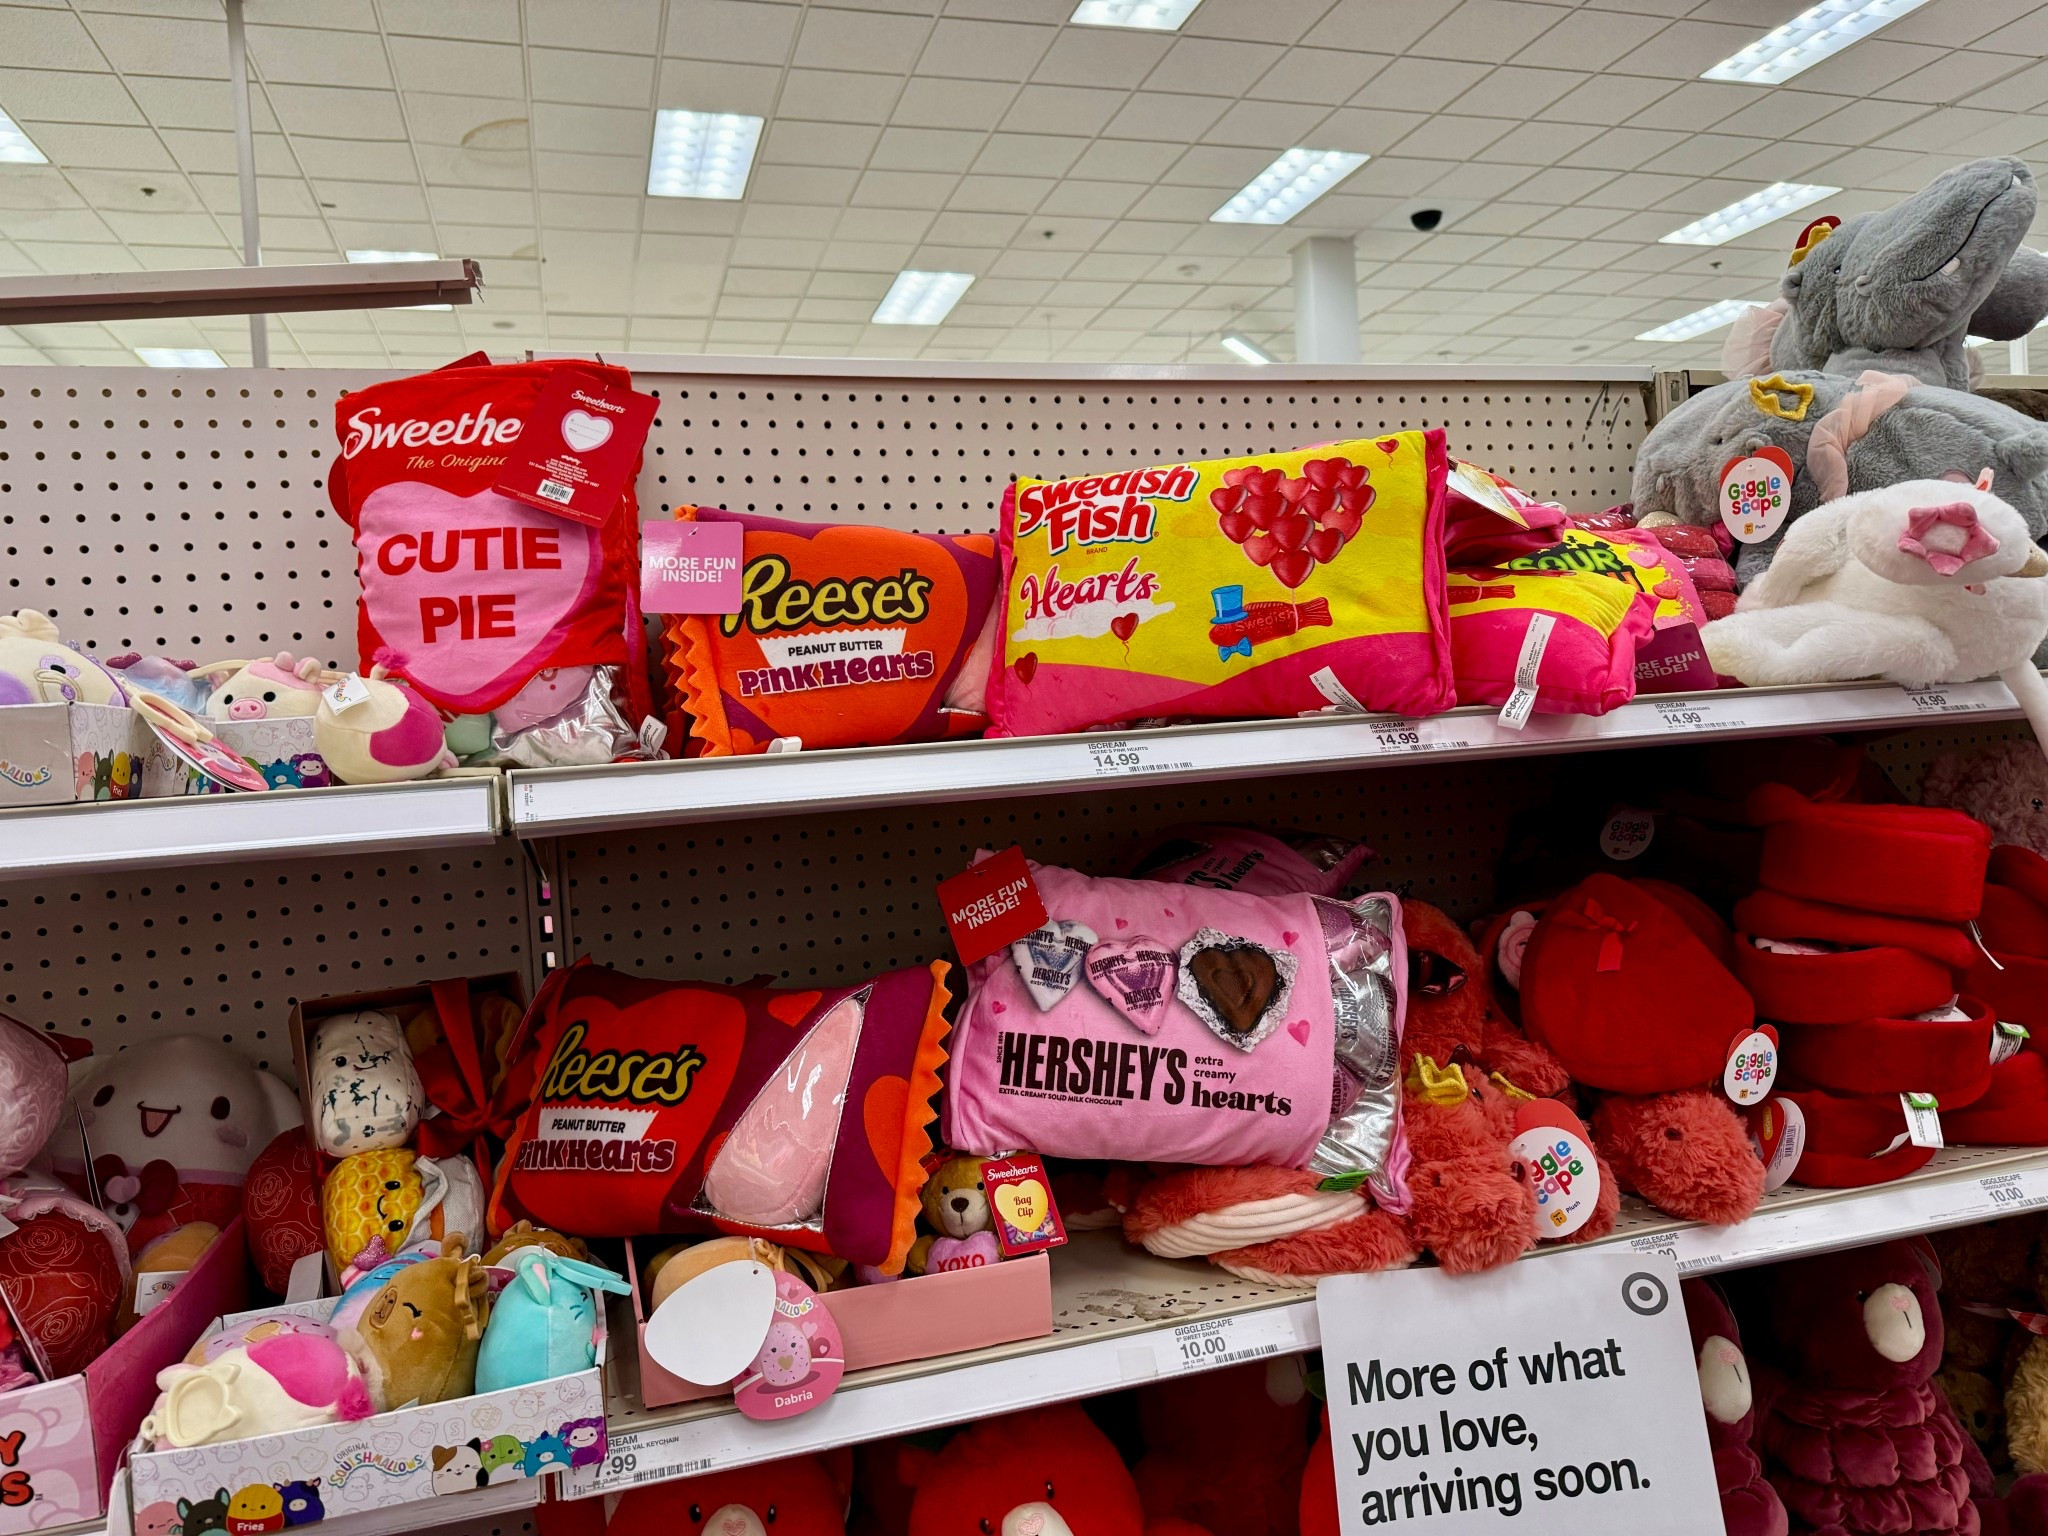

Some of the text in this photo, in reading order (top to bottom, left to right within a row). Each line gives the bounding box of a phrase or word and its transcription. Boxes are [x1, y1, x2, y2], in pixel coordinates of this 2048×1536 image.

[571, 389, 626, 414] Sweethearts
[343, 402, 525, 461] Sweethe
[406, 454, 435, 470] The
[1045, 496, 1157, 557] Fish
[377, 527, 562, 577] CUTIE
[1086, 546, 1108, 555] BRAND
[650, 556, 736, 570] MORE FUN
[662, 569, 722, 583] INSIDE!
[722, 556, 932, 635] Reese's
[1020, 556, 1161, 620] Hearts
[419, 594, 517, 644] PIE
[788, 640, 883, 656] PEANUT BUTTER
[1664, 651, 1701, 666] FUN
[1912, 695, 1947, 707] 14.99
[1663, 712, 1702, 725] 14.99
[1088, 742, 1127, 750] ISCREAM
[1376, 732, 1419, 746] 14.99
[1094, 753, 1140, 768] 14.99
[951, 877, 1028, 924] MORE FUN
[967, 894, 1020, 930] INSIDE!
[1090, 954, 1127, 975] HERSHEY'S
[1032, 967, 1071, 986] HERSHEY'S
[1124, 986, 1162, 1005] HERSHEY'S
[1000, 1031, 1188, 1105] HERSHEY'S
[1194, 1055, 1223, 1066] extra
[1193, 1068, 1236, 1084] creamy
[999, 1088, 1123, 1106] EXTRA CREAMY SOLID MILK CHOCOLATE
[1190, 1081, 1292, 1116] hearts
[552, 1118, 626, 1133] PEANUT BUTTER
[987, 1165, 1039, 1182] Sweethearts
[1980, 1173, 2022, 1186] GIGGLESCAPE
[1013, 1195, 1032, 1206] Bag
[1989, 1187, 2024, 1202] 10.00
[1017, 1207, 1034, 1218] Clip
[1565, 1200, 1581, 1214] Plush
[1631, 1232, 1680, 1247] GIGGLESCAPE
[1639, 1244, 1656, 1252] PRINCE
[1656, 1241, 1675, 1249] DRAGON
[937, 1253, 986, 1273] XOXO
[1174, 1318, 1233, 1336] GIGGLESCAPE
[1183, 1333, 1201, 1341] SWEET
[1202, 1329, 1220, 1337] SNAKE
[1180, 1336, 1226, 1359] 10.00
[1347, 1338, 1626, 1406] More of what
[774, 1389, 813, 1408] Dabria
[646, 1436, 680, 1448] KEYCHAIN
[1352, 1410, 1538, 1476] you love,
[337, 1442, 369, 1460] ORIGINAL
[1361, 1458, 1650, 1526] arriving soon.
[237, 1522, 265, 1532] Fries
